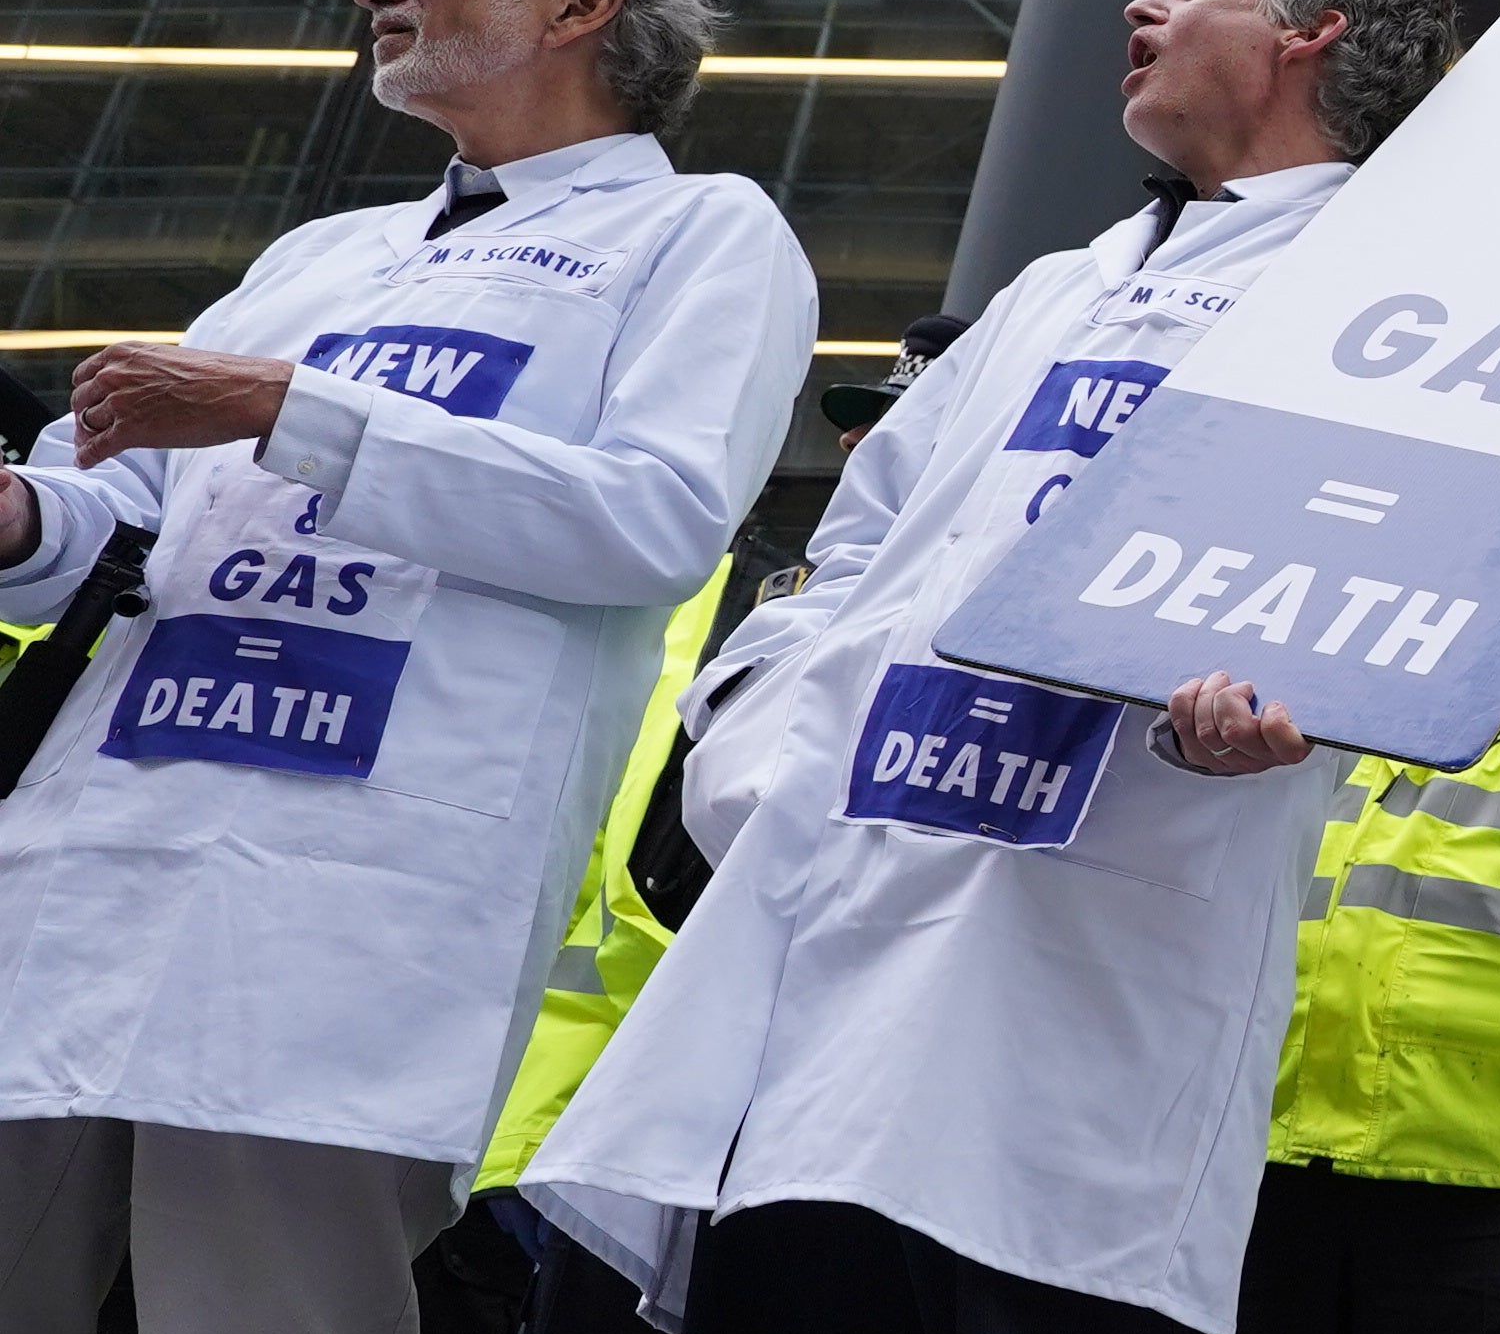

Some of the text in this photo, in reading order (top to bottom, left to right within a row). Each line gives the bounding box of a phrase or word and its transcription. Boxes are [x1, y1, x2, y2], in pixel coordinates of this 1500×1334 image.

[326, 341, 485, 399] NEW
[1058, 376, 1146, 435] NE
[209, 549, 376, 616] GAS
[1078, 528, 1479, 677] DEATH
[137, 677, 353, 745] DEATH
[872, 730, 1072, 814] DEATH
